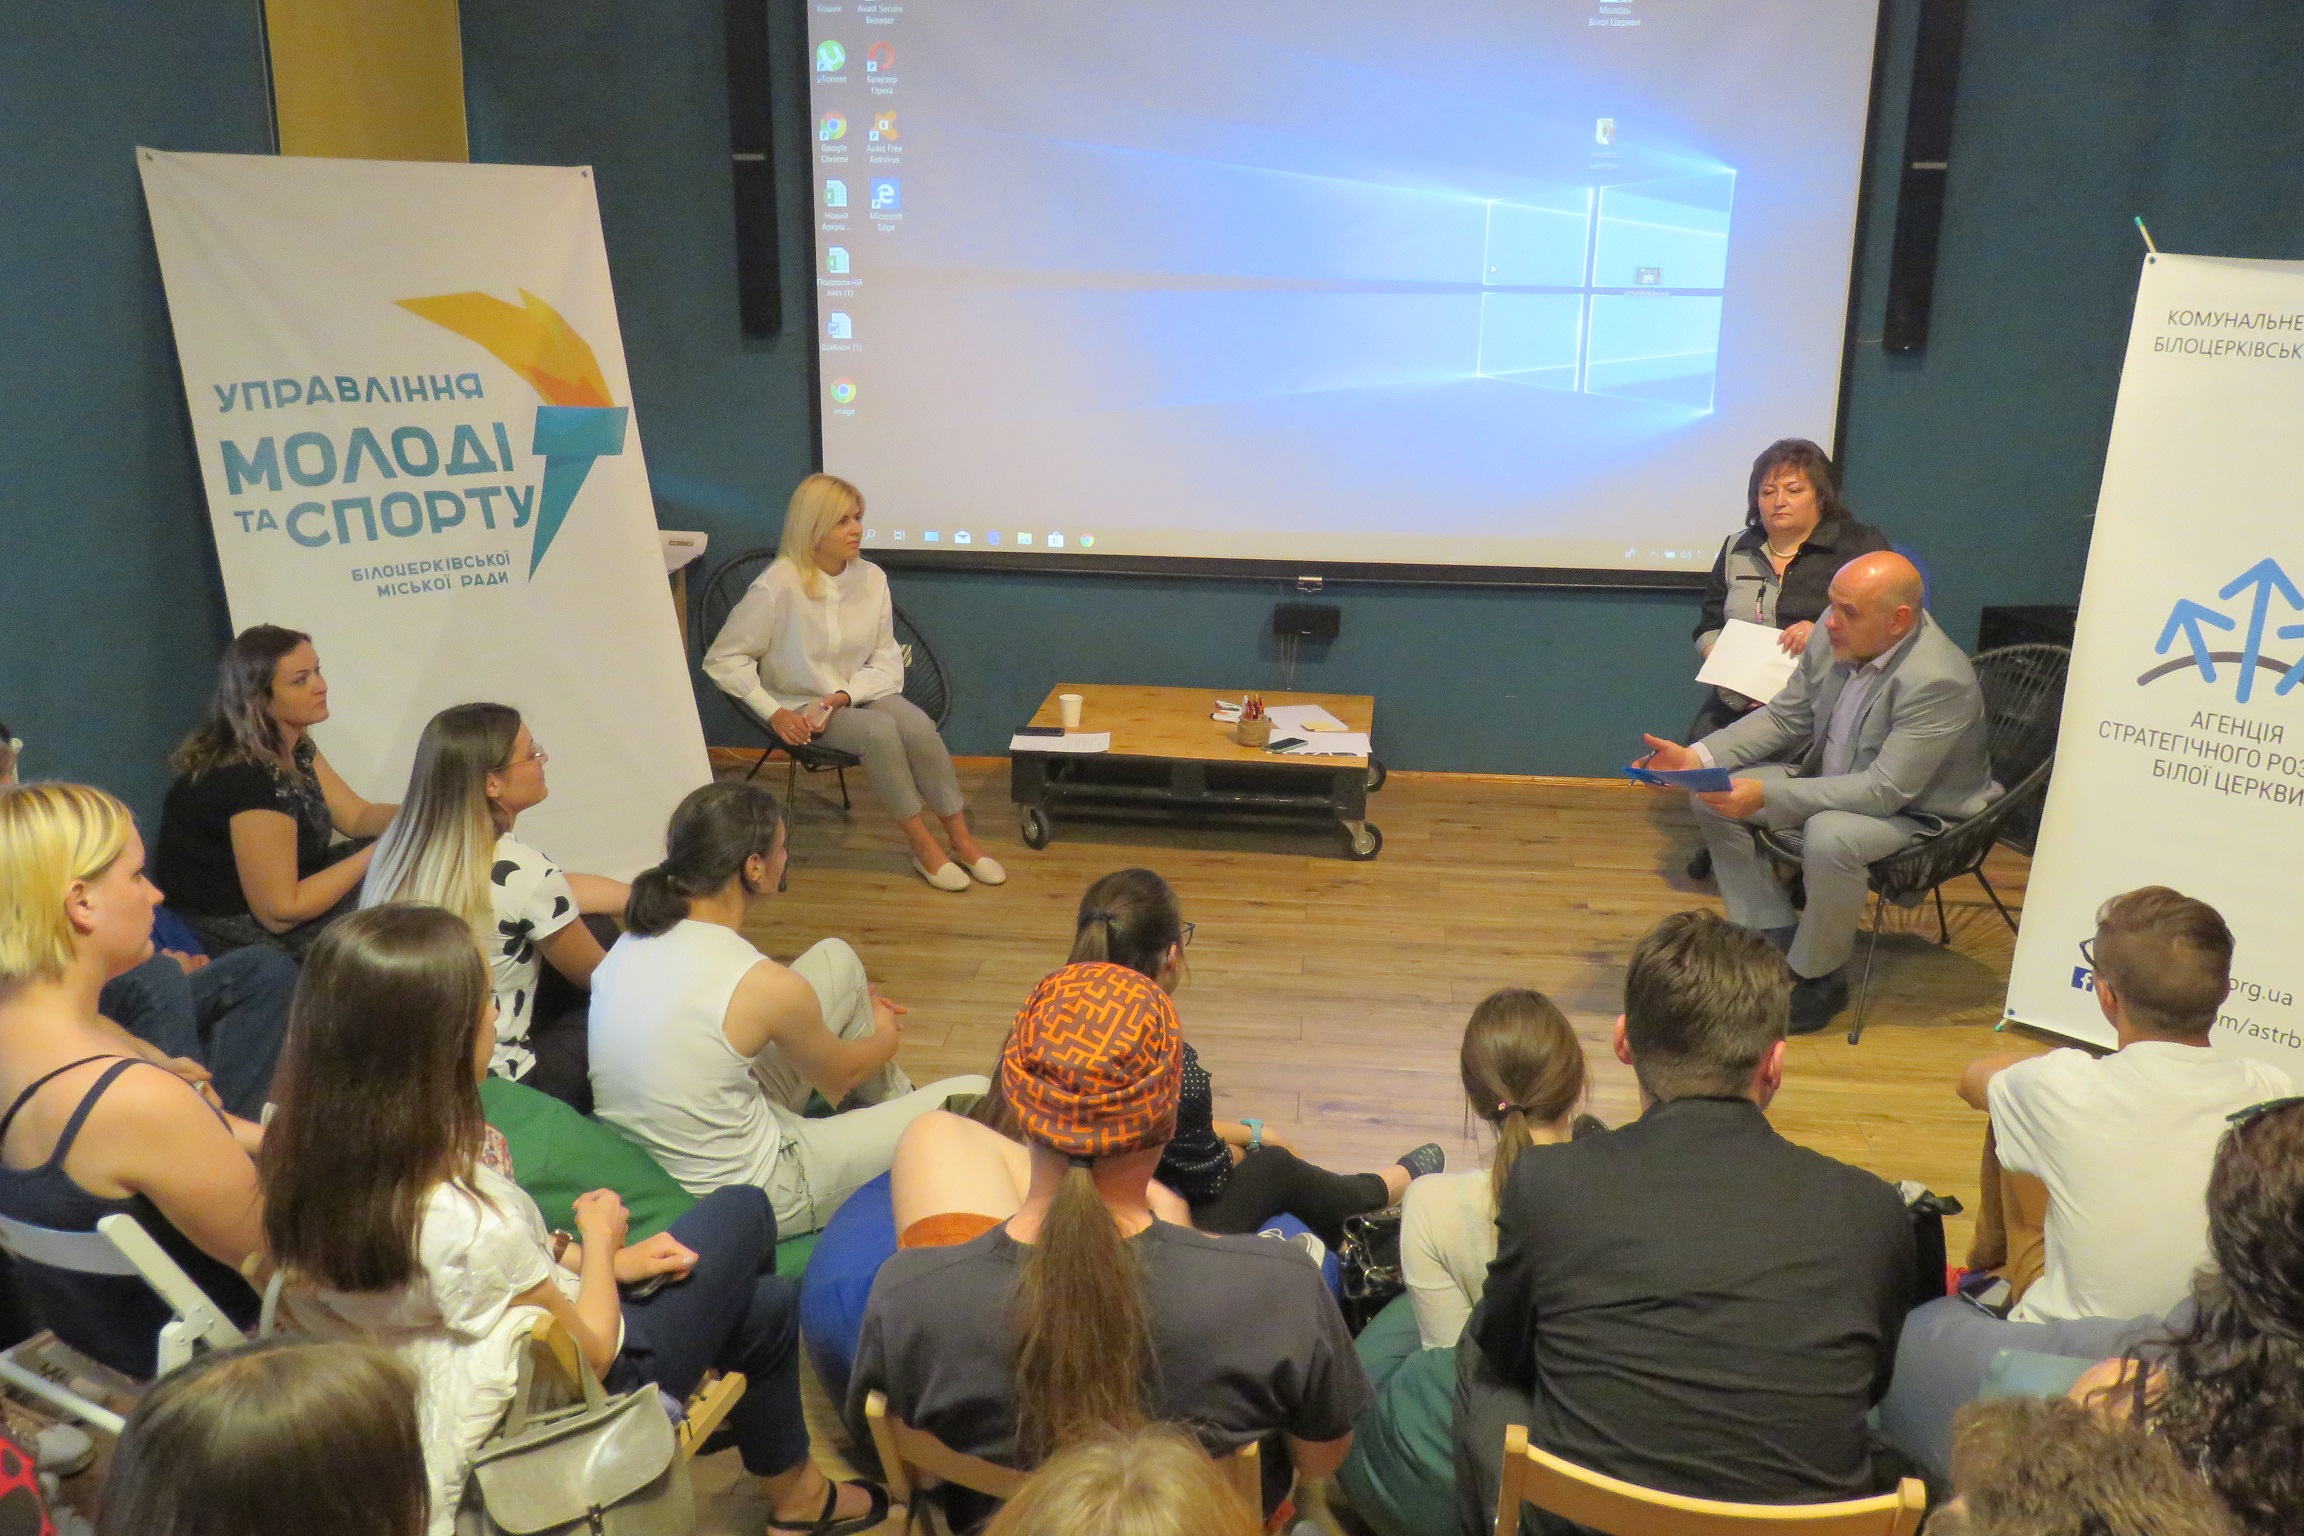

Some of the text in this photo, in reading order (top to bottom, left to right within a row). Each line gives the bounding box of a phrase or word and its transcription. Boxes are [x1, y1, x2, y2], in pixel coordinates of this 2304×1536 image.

[857, 5, 877, 13] Avast
[866, 16, 895, 24] Browser
[871, 87, 894, 95] Opera
[821, 144, 847, 153] Google
[866, 144, 903, 153] Avast Free
[869, 156, 900, 164] Antivirus
[824, 211, 849, 220] Новий
[869, 212, 903, 221] Microsoft
[822, 223, 846, 232] Аркуш
[877, 223, 895, 232] Edge
[817, 278, 863, 287] Подорожній
[826, 289, 854, 298] лист (1)
[2167, 310, 2304, 331] КОМУНАЛЬНЕ
[821, 343, 862, 352] Шаблон (1)
[2153, 336, 2302, 360] БІЛОЦЕРКІВСЬК
[213, 372, 484, 413] УПРАВЛІННЯ
[833, 407, 856, 416] image
[219, 421, 514, 496] МОЛОДІ
[234, 484, 536, 549] ТА СПОРТУ
[351, 549, 512, 583] БІЛОЦЕРКІВСЬКОЇ
[377, 571, 509, 599] МІСЬКОЇ РАДИ
[2189, 710, 2285, 745] АГЕНЦІЯ
[2098, 720, 2262, 768] СТРАТЕГІЧНОГО
[2152, 759, 2304, 807] БІЛОЇ ЦЕРКВИ
[2228, 977, 2294, 1007] org.ua
[2216, 1013, 2304, 1050] m/astrb
